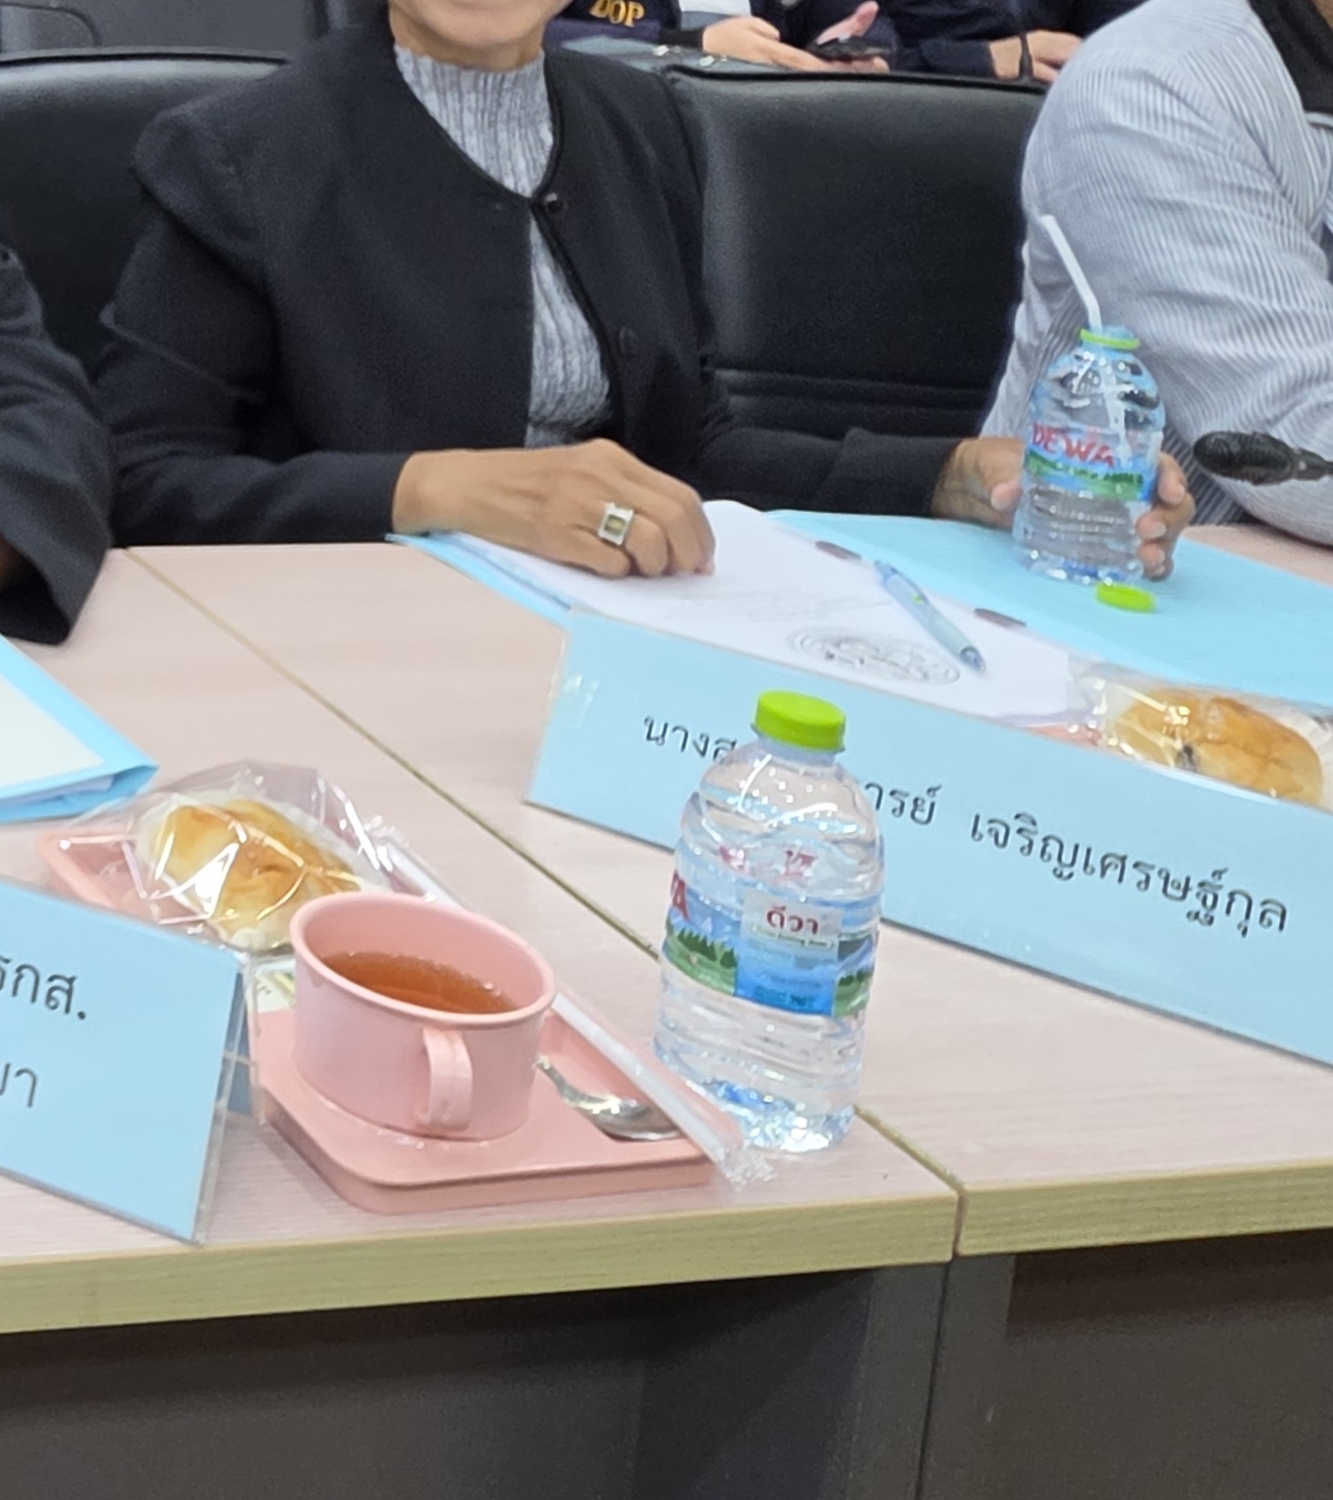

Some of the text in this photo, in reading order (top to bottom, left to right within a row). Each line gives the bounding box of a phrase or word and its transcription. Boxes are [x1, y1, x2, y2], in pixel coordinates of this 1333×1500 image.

[970, 810, 1289, 938] เจริญเศรษฐ์กุล
